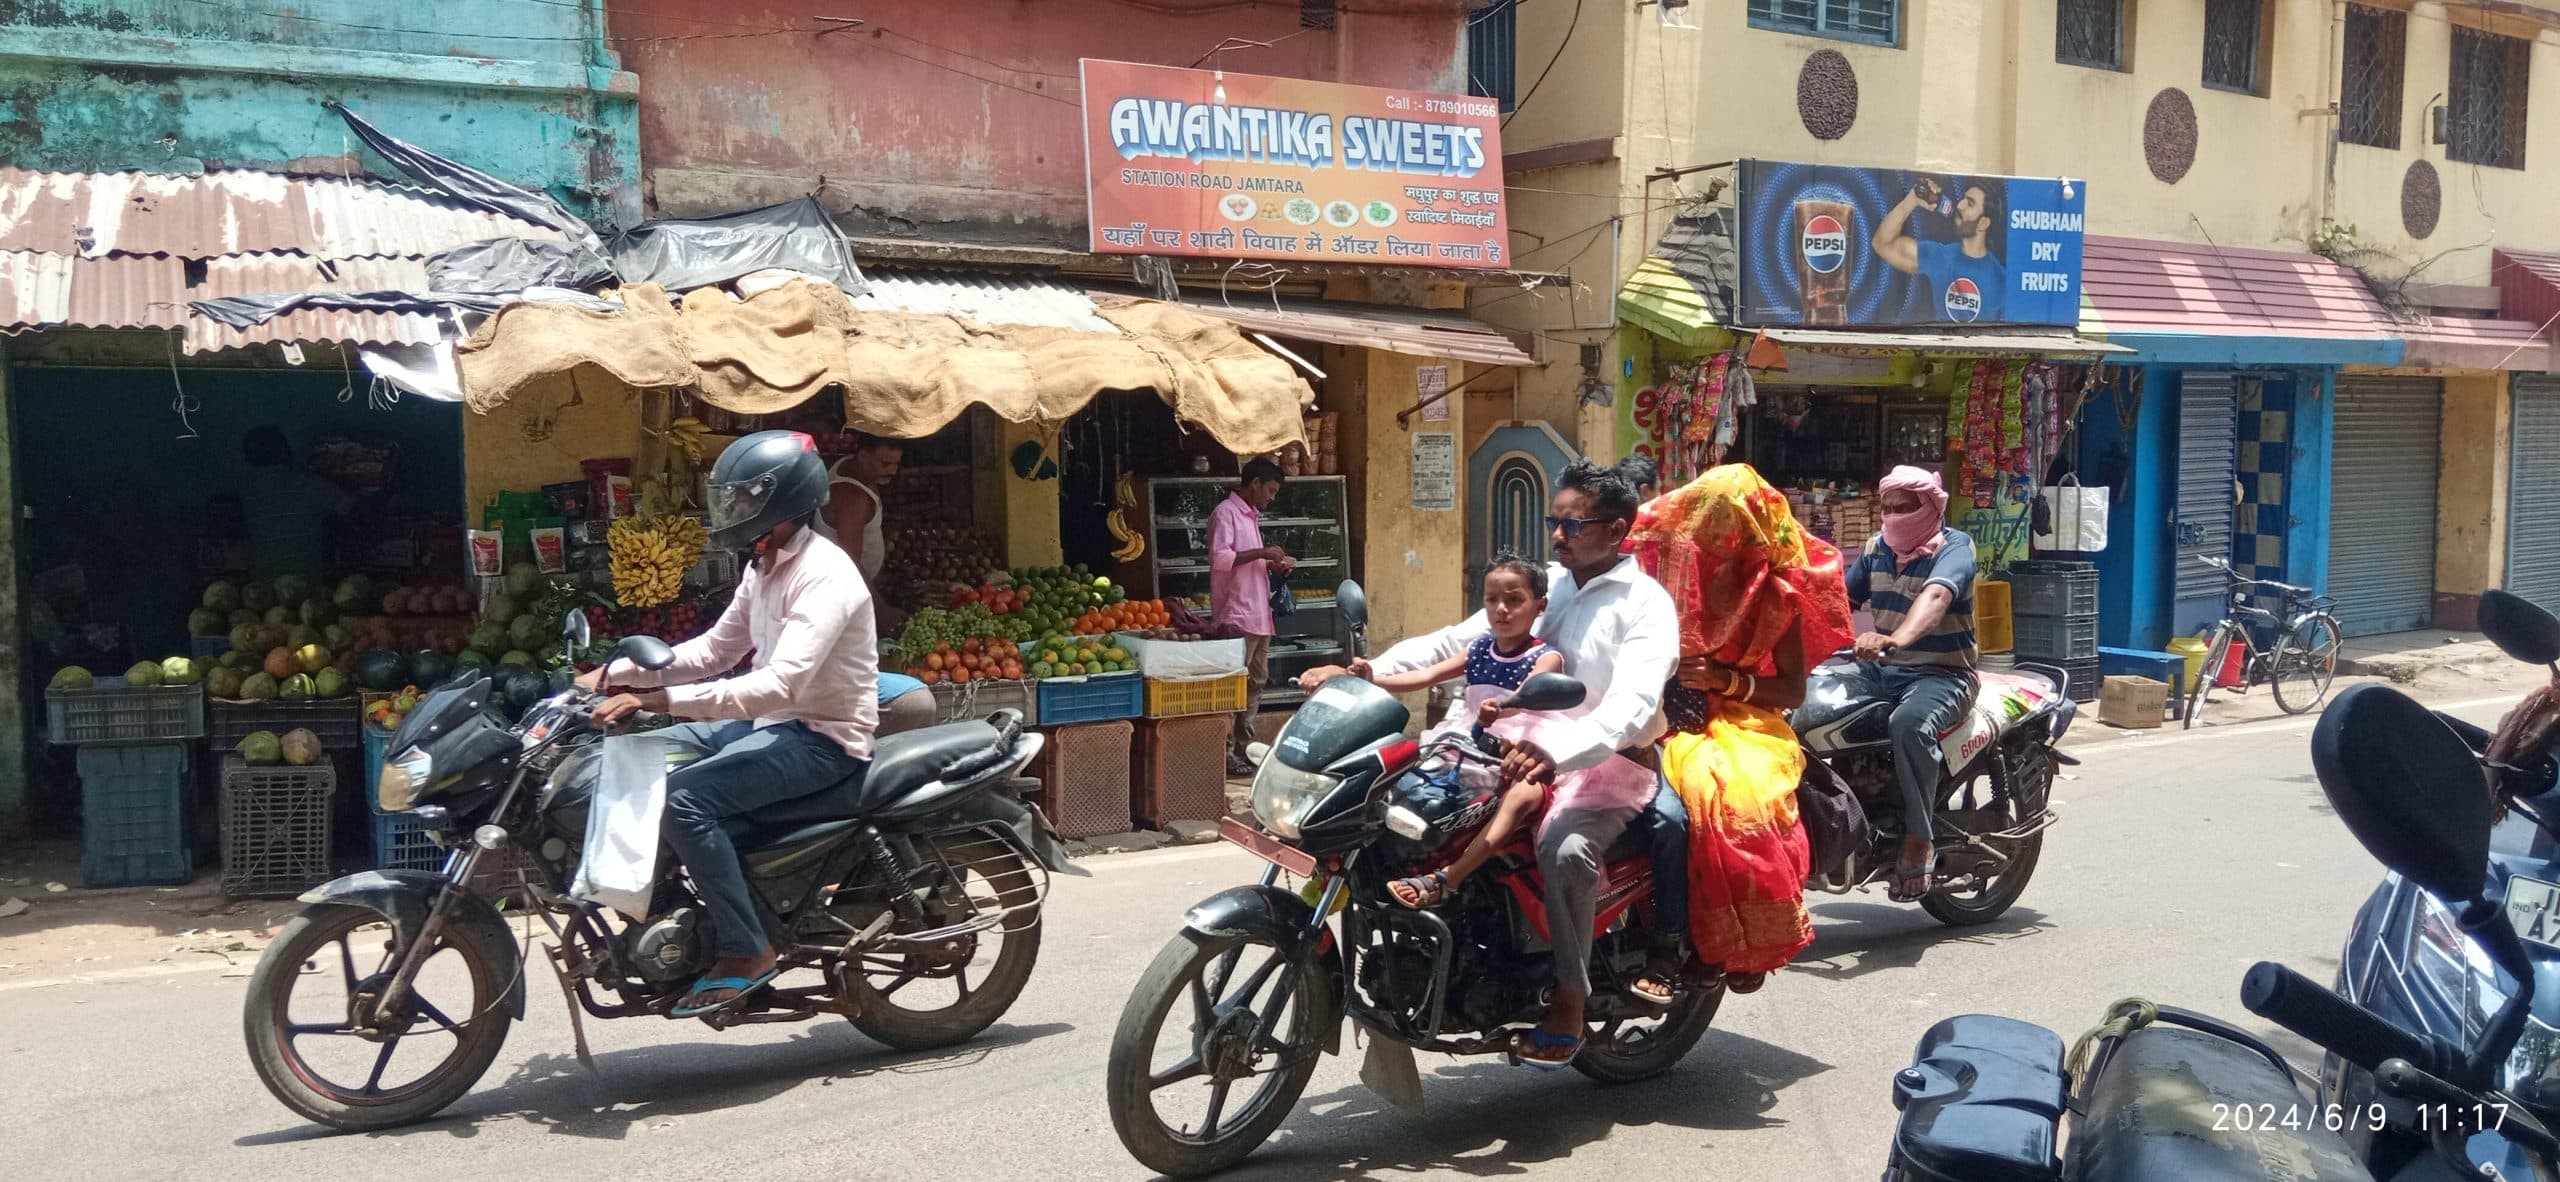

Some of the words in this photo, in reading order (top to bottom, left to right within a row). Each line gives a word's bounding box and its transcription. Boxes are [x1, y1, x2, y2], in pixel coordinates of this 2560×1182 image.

[1386, 96, 1410, 109] Call
[1425, 99, 1496, 117] 8789010566
[1110, 97, 1333, 171] AWANTIKA
[1342, 115, 1486, 177] SWEETS
[1121, 169, 1186, 187] STATION
[1189, 174, 1233, 191] ROAD
[1236, 177, 1304, 194] JAMTARA
[1441, 188, 1457, 201] का
[1459, 189, 1480, 207] शुद्ध
[1406, 206, 1448, 223] स्वादिष्ट
[2011, 210, 2082, 233] SHUBHAM
[1103, 223, 1145, 246] यहाँ
[1151, 230, 1181, 247] पर
[1189, 228, 1234, 249] शादी
[1242, 228, 1297, 252] विवाह
[1304, 231, 1323, 252] में
[1386, 234, 1431, 257] लिया
[1438, 243, 1481, 259] जाता
[1486, 239, 1500, 262] है
[1805, 237, 1846, 252] PEPSI
[2031, 241, 2060, 262] DRY
[2021, 272, 2068, 292] FRUITS
[1948, 292, 1979, 309] PEPSI
[2511, 902, 2531, 914] IND
